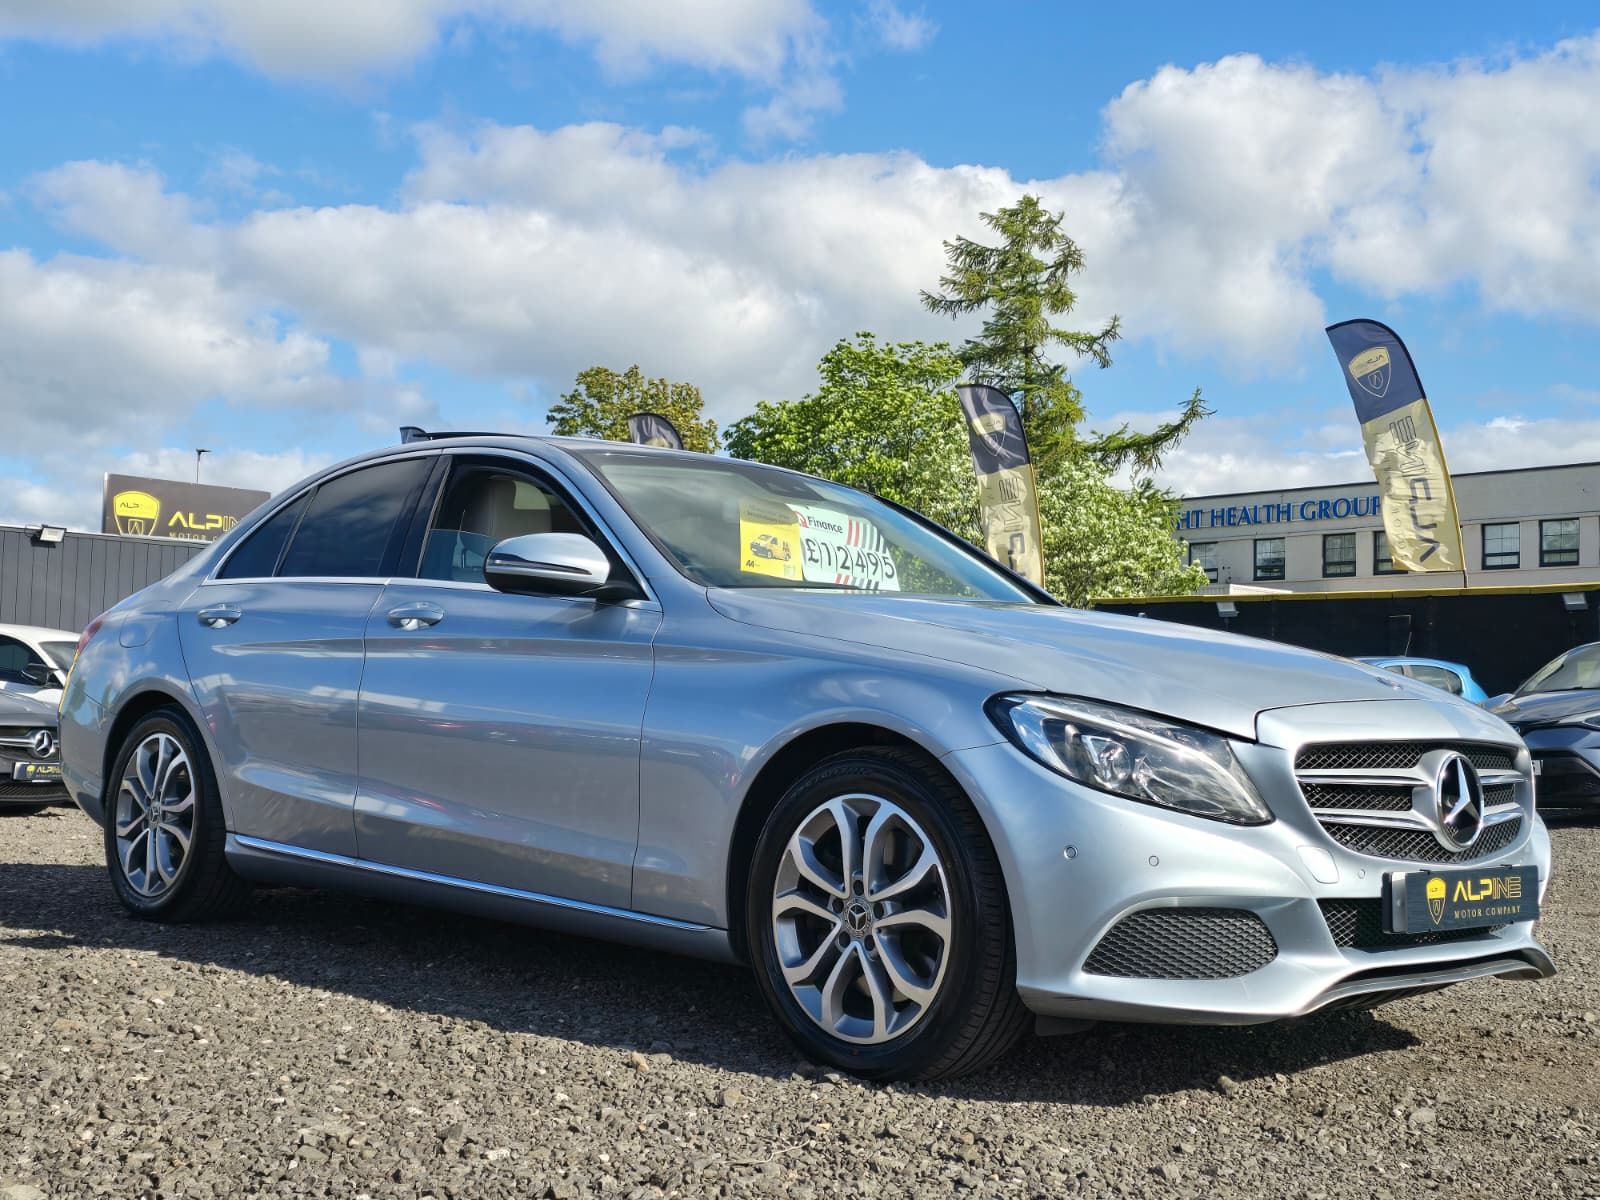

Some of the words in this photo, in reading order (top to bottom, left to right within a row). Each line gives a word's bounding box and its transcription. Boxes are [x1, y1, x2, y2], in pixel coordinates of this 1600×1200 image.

[807, 516, 844, 534] Finance
[1210, 502, 1292, 527] HEALTH
[805, 538, 895, 579] £12495
[1453, 877, 1522, 902] ALPINE
[1454, 909, 1483, 919] MOTOR
[1485, 905, 1521, 916] COMPANY
